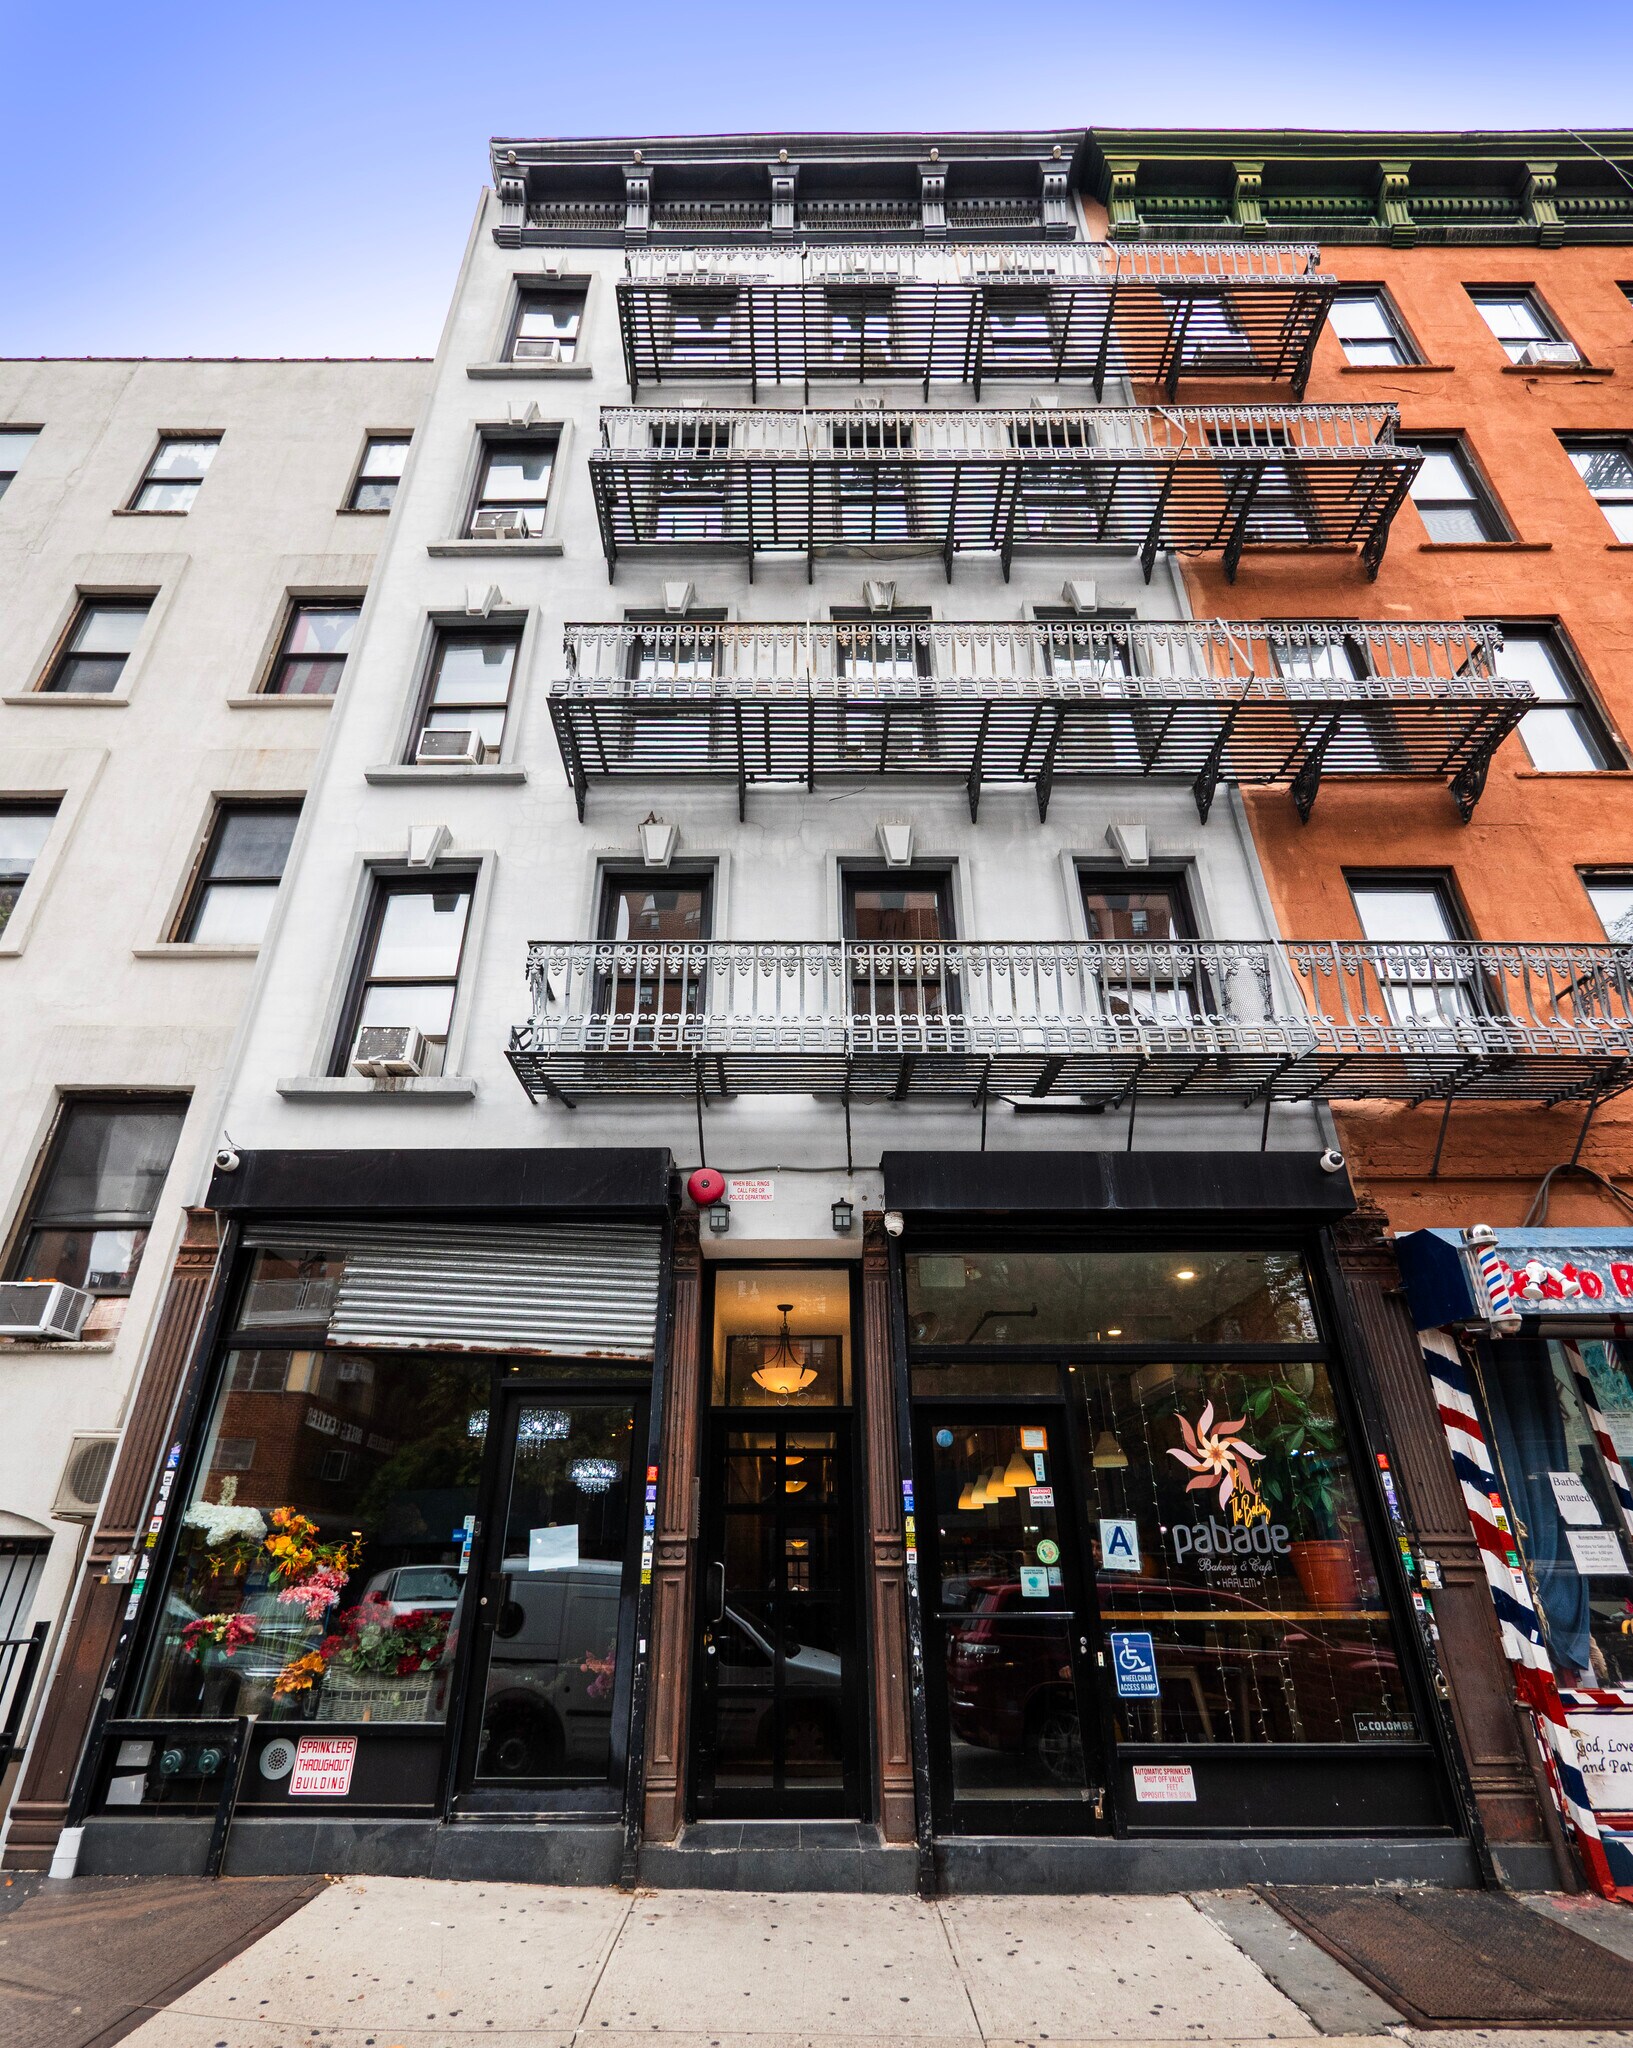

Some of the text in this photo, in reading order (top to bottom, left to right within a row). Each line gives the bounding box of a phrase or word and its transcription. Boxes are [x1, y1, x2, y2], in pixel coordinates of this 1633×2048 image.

[1558, 1494, 1592, 1502] wanted
[1108, 1526, 1132, 1555] A
[1172, 1514, 1292, 1564] pabade
[1198, 1558, 1237, 1574] Bakery
[1240, 1561, 1247, 1572] &
[1222, 1578, 1257, 1588] HARLEM
[1121, 1674, 1153, 1682] WHEELCHAIR
[1368, 1721, 1414, 1731] COLOMBE
[301, 1742, 353, 1753] SPRINKLERS
[299, 1759, 350, 1771] THROUGHOUT
[1582, 1757, 1606, 1773] and
[296, 1777, 345, 1789] BUILDING
